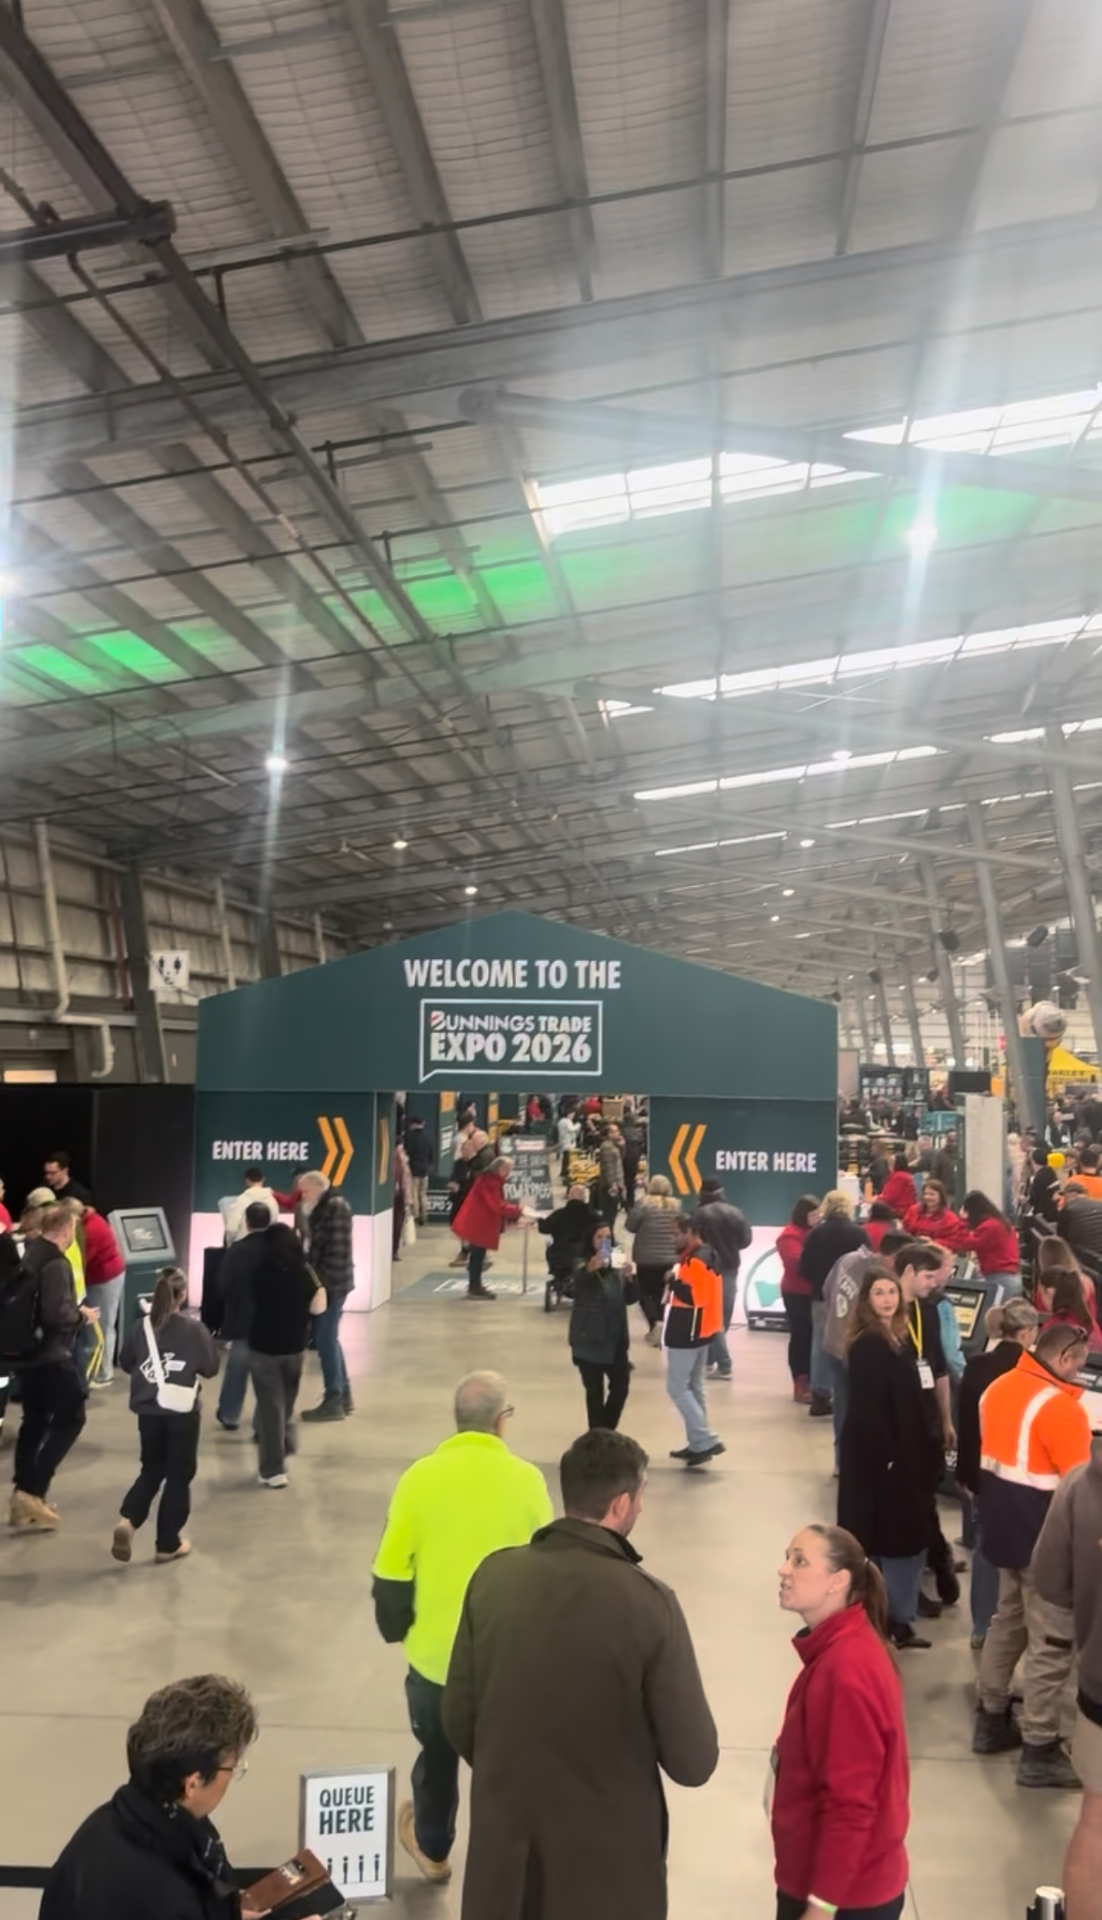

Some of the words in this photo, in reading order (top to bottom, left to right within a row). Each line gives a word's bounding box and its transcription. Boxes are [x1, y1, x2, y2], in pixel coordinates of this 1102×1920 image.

[403, 959, 528, 988] WELCOME
[535, 959, 568, 989] TO
[574, 960, 622, 989] THE
[430, 1010, 535, 1032] BUNNINGS
[538, 1015, 592, 1033] TRADE
[430, 1032, 506, 1062] EXPO
[510, 1033, 592, 1063] 2026
[212, 1140, 263, 1160] ENTER
[266, 1141, 309, 1161] HERE
[715, 1150, 769, 1171] ENTER
[772, 1152, 817, 1173] HERE
[319, 1786, 375, 1808] QUEUE
[319, 1807, 375, 1835] HERE
